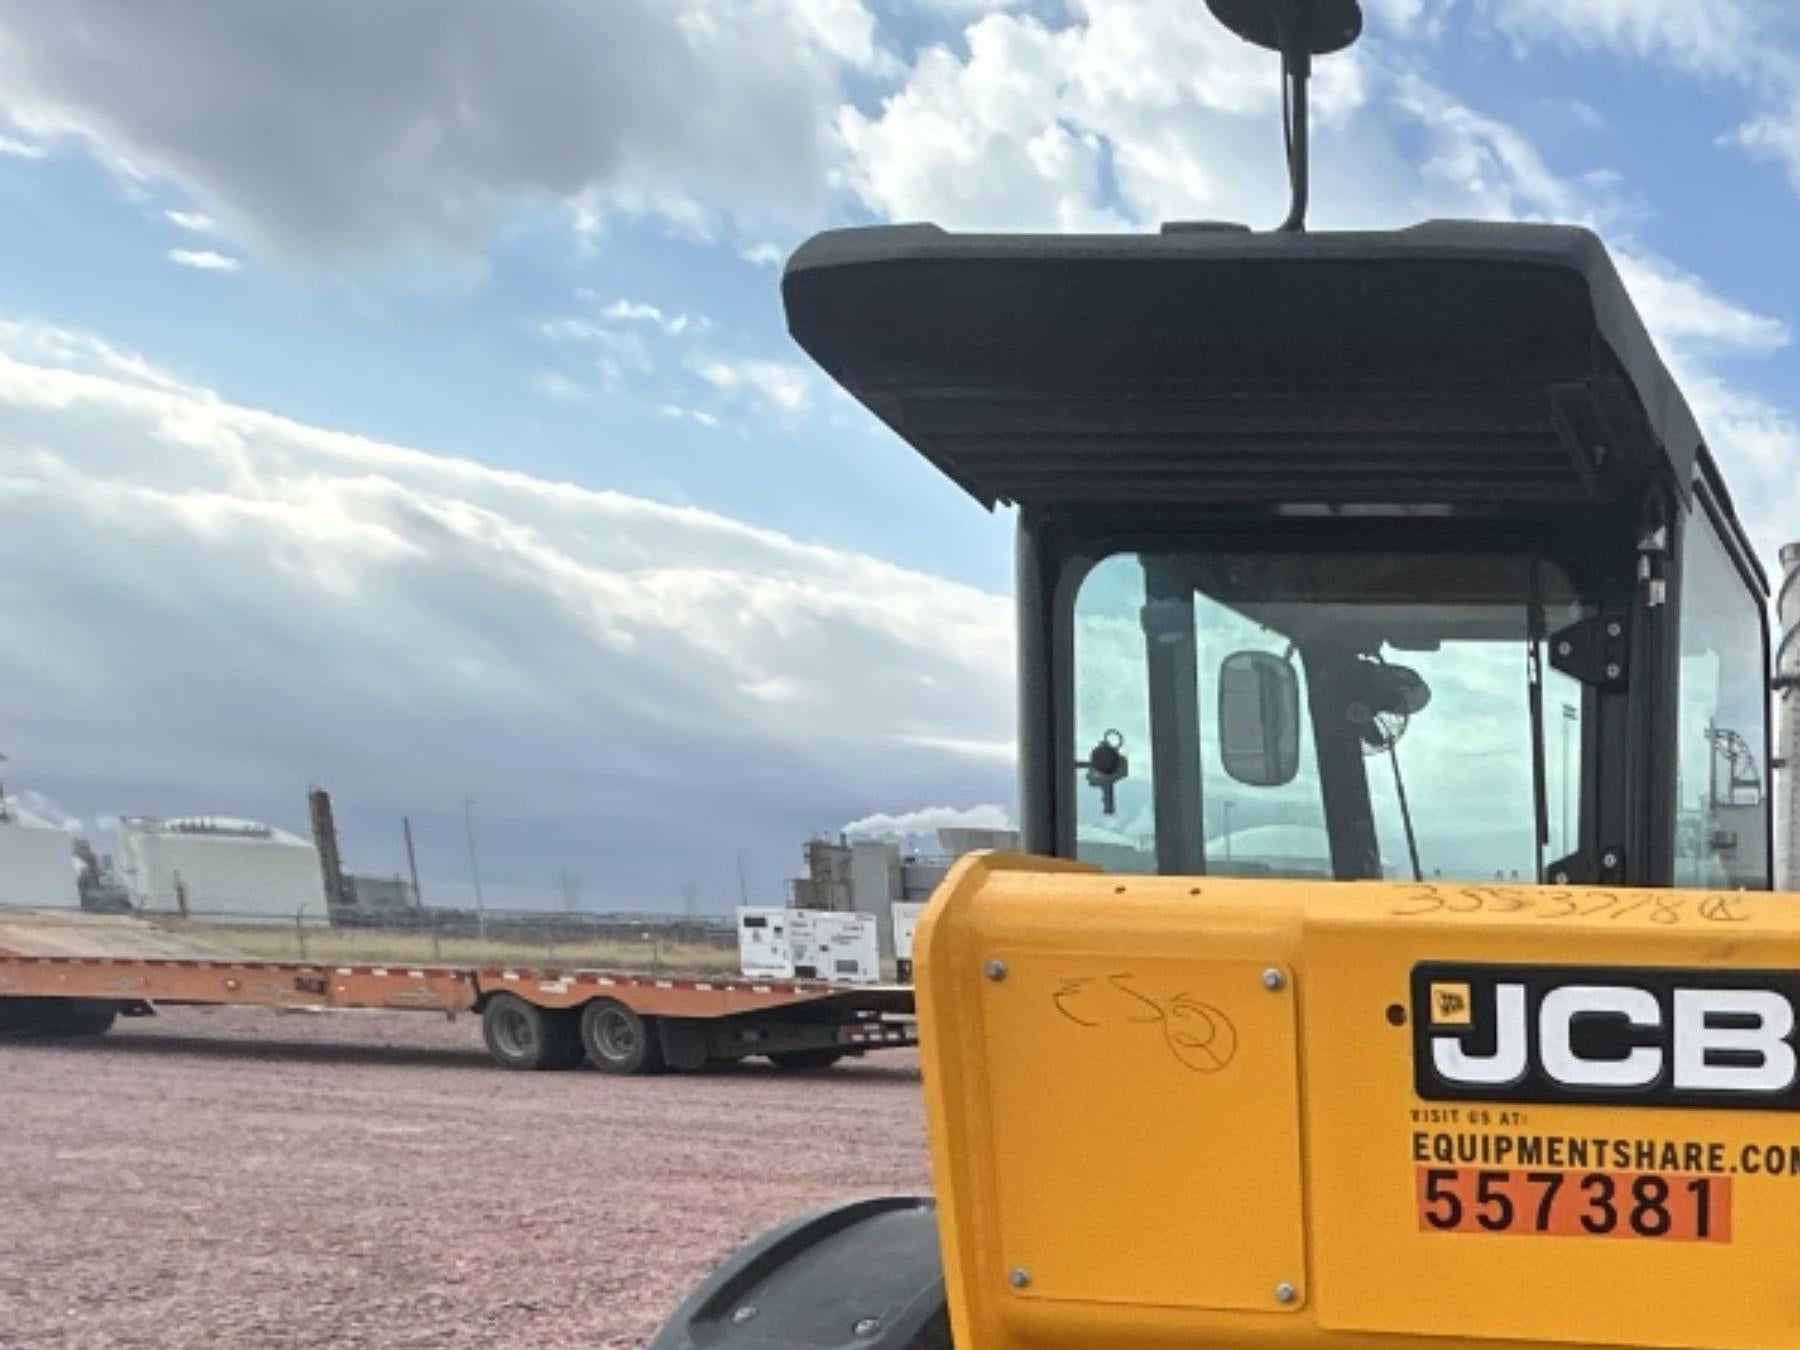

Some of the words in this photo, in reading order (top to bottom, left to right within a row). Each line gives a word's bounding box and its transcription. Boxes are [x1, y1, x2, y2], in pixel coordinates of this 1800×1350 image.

[1431, 983, 1797, 1091] JCB
[1410, 1109, 1459, 1123] VISIT
[1468, 1110, 1491, 1126] US
[1425, 1169, 1711, 1238] 557381
